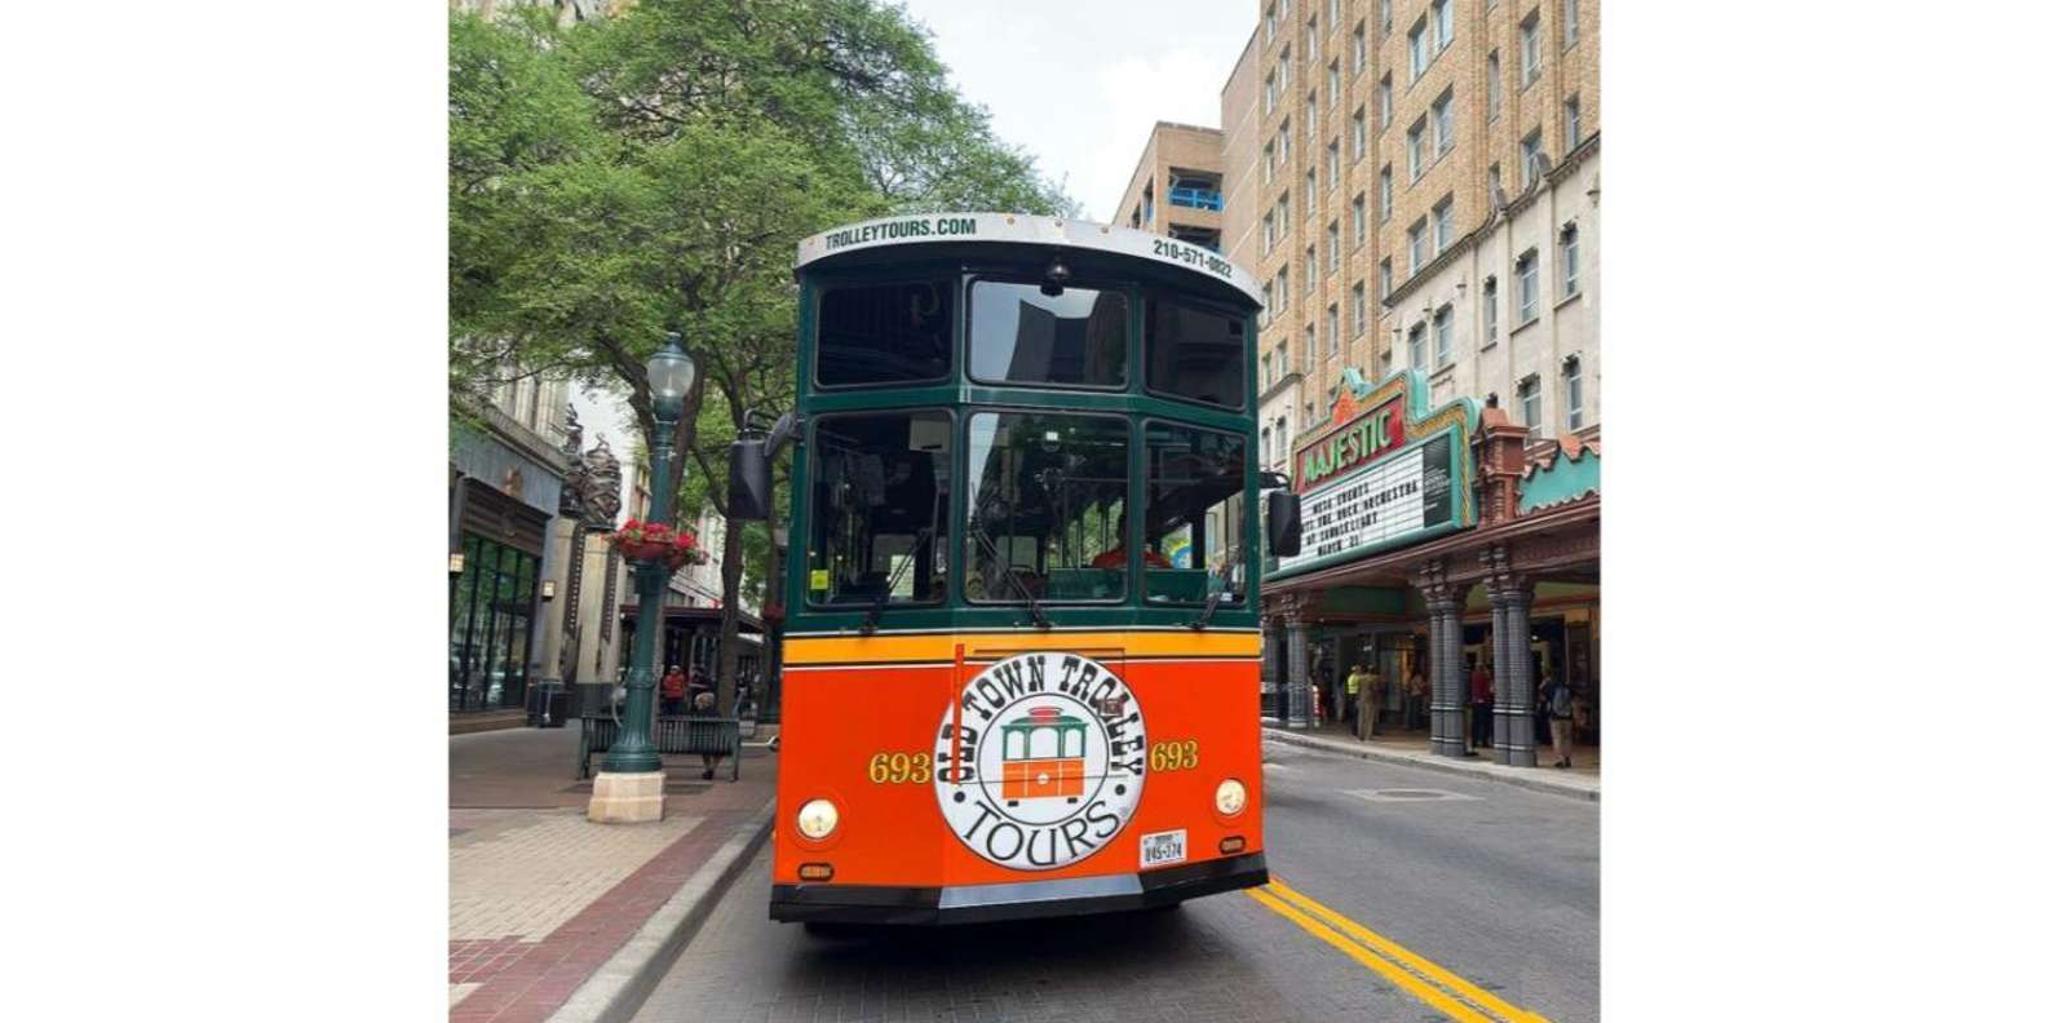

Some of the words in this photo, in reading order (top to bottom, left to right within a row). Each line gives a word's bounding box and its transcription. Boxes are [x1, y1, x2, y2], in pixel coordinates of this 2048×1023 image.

[825, 218, 977, 250] TROLLEYTOURS.COM
[1304, 409, 1392, 481] MAJESTIC
[1363, 480, 1418, 509] ORCHESTRA
[937, 723, 978, 783] OLD
[962, 655, 1047, 721] TOWN
[868, 751, 932, 785] 693
[1150, 739, 1199, 773] 693
[963, 800, 1120, 866] TOURS
